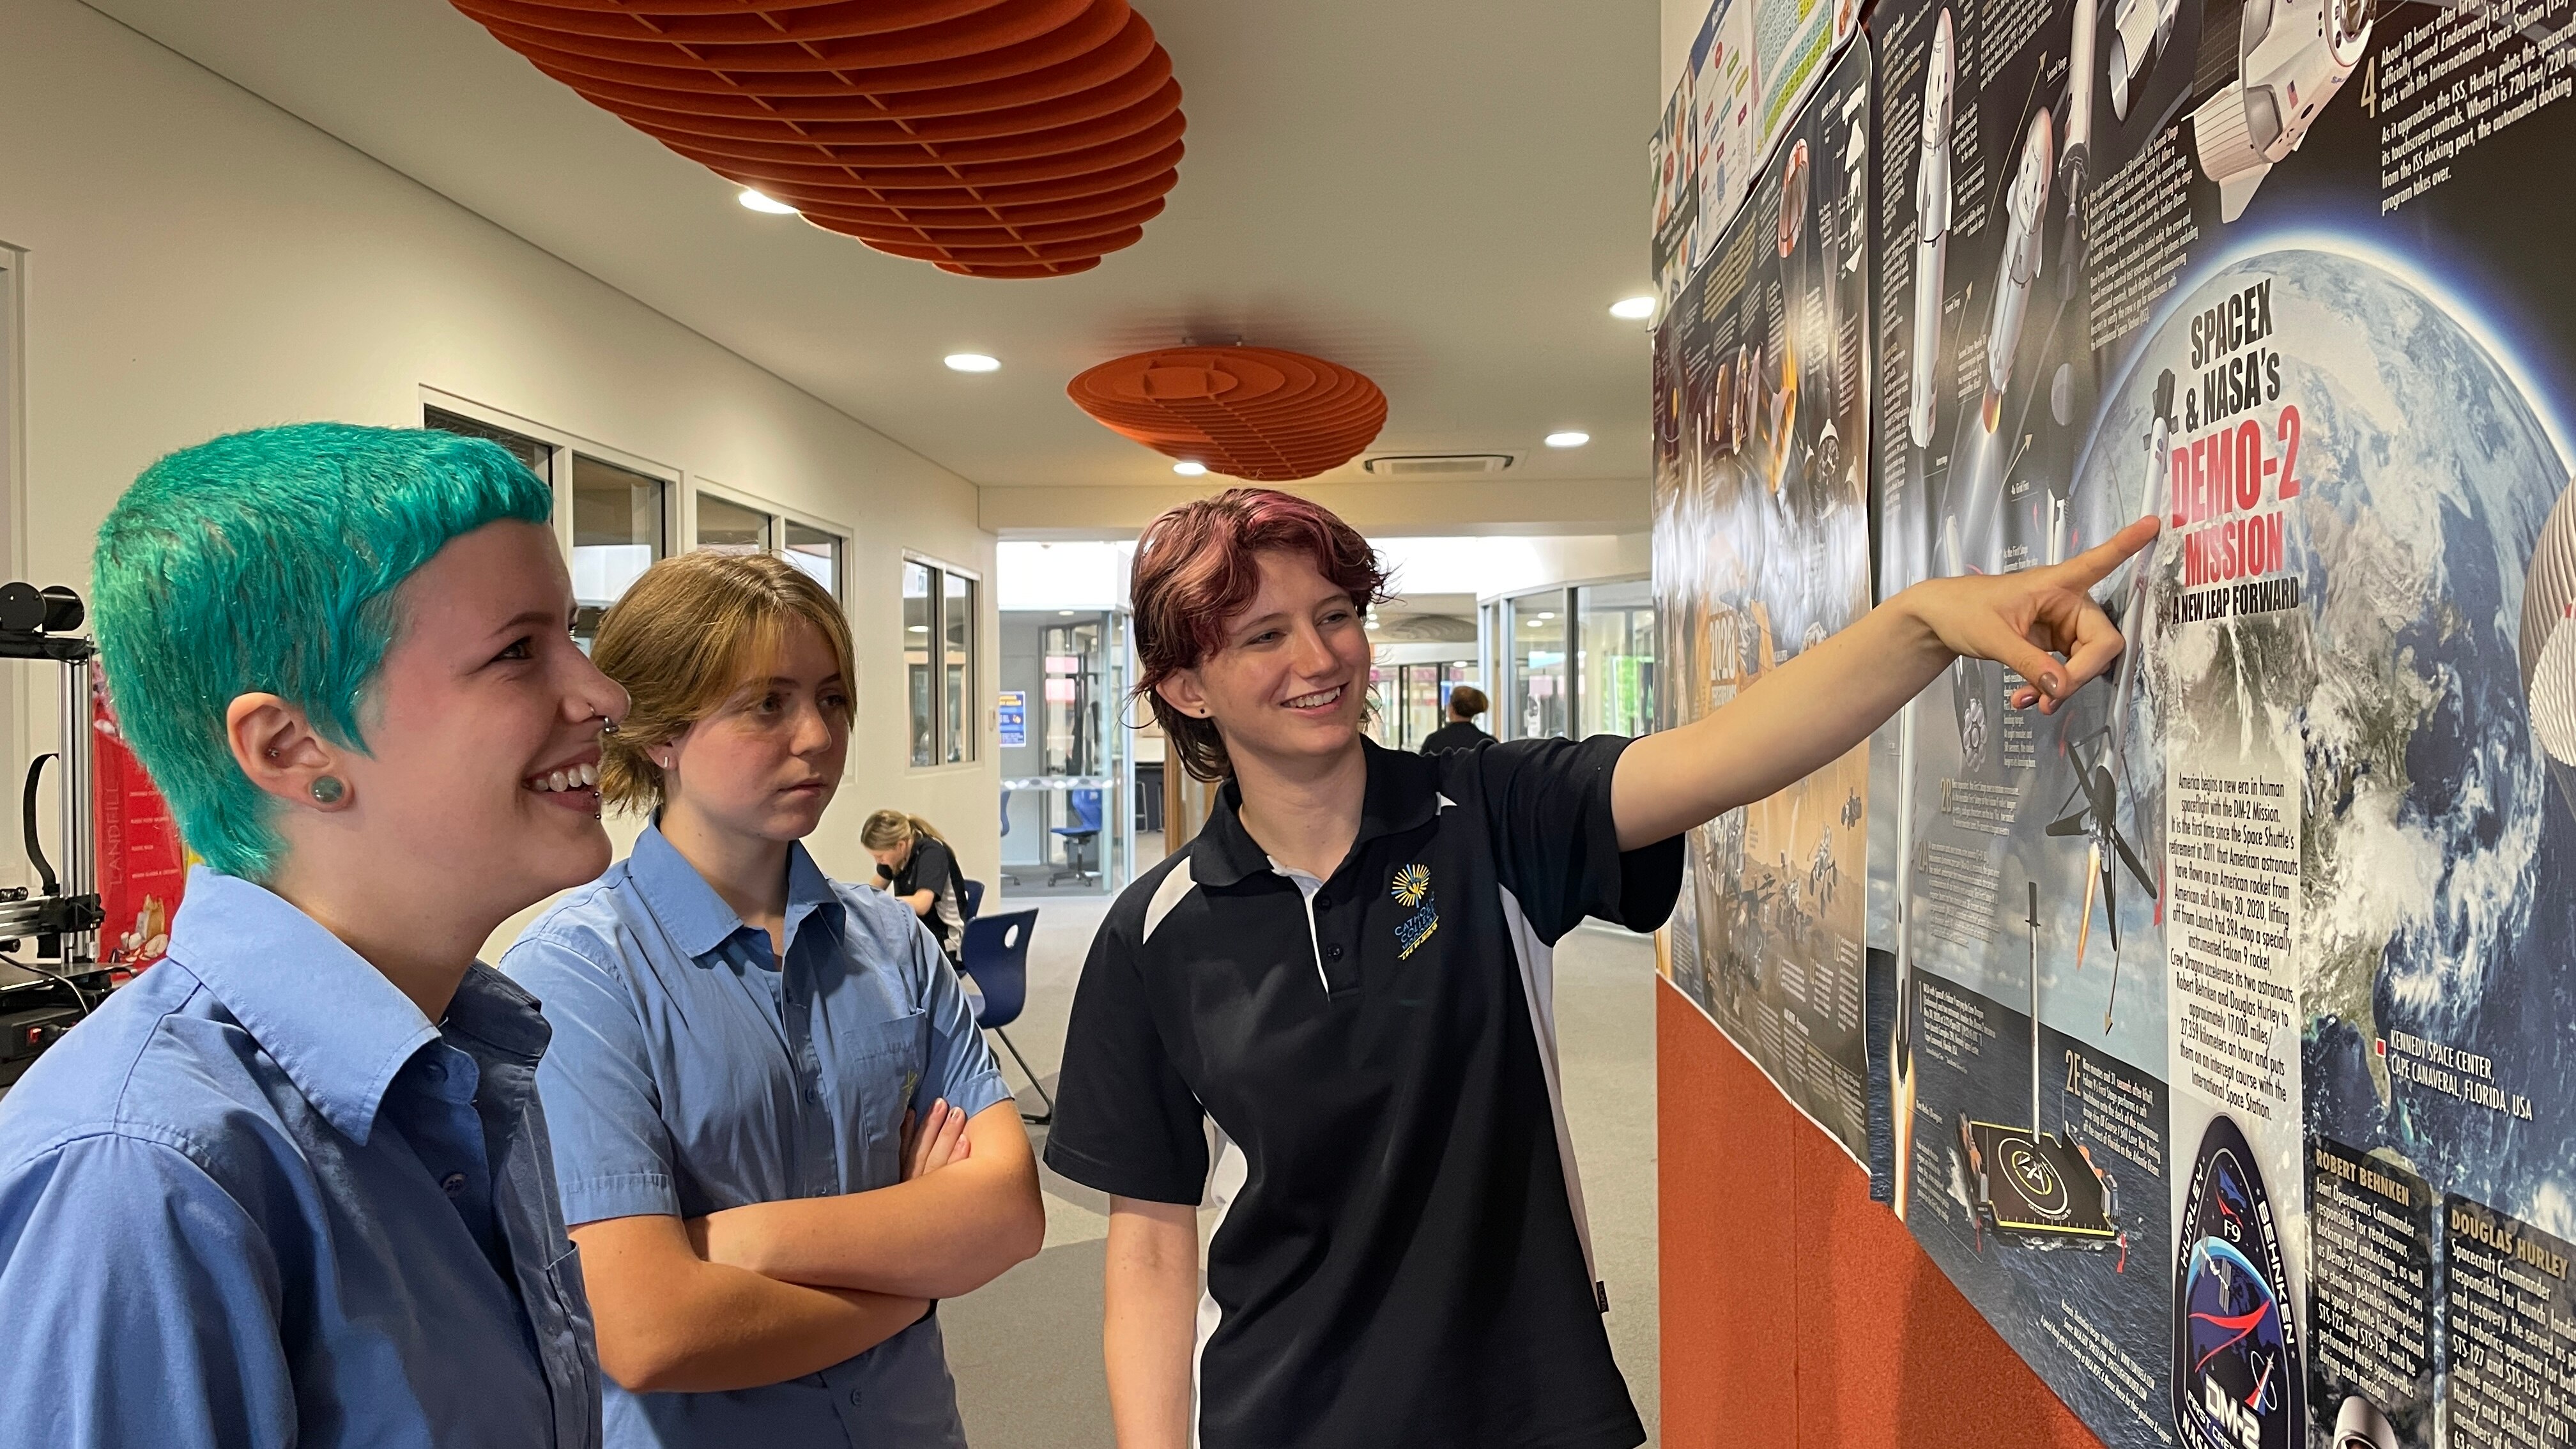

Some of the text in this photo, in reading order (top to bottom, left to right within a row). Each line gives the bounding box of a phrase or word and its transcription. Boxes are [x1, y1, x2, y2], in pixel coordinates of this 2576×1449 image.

[2381, 41, 2402, 67] About
[2404, 31, 2412, 52] 18
[2414, 21, 2434, 45] hours
[2436, 6, 2457, 29] after
[2381, 56, 2411, 89] officially
[2413, 35, 2438, 69] named
[2441, 5, 2489, 51] Endeavour)
[2491, 3, 2499, 21] is
[2501, 0, 2510, 20] in
[2382, 87, 2398, 112] dock
[2400, 76, 2414, 100] with
[2416, 70, 2427, 91] the
[2430, 33, 2485, 82] International
[2487, 24, 2511, 52] Space
[2514, 4, 2544, 33] Station
[2361, 56, 2377, 118] 4
[2382, 42, 2535, 144] As it approaches the ISS, Hurley pilots the
[2382, 150, 2391, 166] its
[2391, 128, 2432, 162] touchscreen
[2432, 105, 2465, 138] controls.
[2466, 96, 2492, 120] When
[2492, 86, 2498, 108] it
[2500, 86, 2508, 102] is
[2509, 76, 2526, 98] 720
[2382, 77, 2572, 188] from the ISS docking port, the automated docking
[2082, 196, 2088, 240] 3
[2382, 167, 2451, 216] program takes over.
[2191, 278, 2273, 371] SPACEX
[2186, 388, 2199, 433] &
[2172, 404, 2301, 529] DEMO-2
[2185, 510, 2283, 587] MISSION
[2173, 577, 2299, 625] A NEW LEAP FORWARD
[1710, 615, 1735, 681] 2020
[2234, 799, 2280, 822] DM-2 Mission.
[2238, 781, 2248, 794] era
[2251, 777, 2257, 795] in
[2260, 775, 2284, 797] human
[105, 782, 123, 885] LANDFILL
[2229, 847, 2297, 876] American astronauts
[2231, 822, 2294, 849] the Space Shuttle's
[2227, 917, 2292, 956] 39A atop a specially
[2235, 896, 2288, 931] 30, 2020, lifting
[2223, 940, 2271, 976] Falcon 9 rocket,
[2066, 1049, 2081, 1097] 2E
[2391, 1029, 2495, 1085] KENNEDY SPACE CENTER,
[2391, 1054, 2533, 1121] CAPE CANAVERAL, FLORIDA, USA
[2316, 1149, 2409, 1207] ROBERT BEHNKEN
[2316, 1176, 2414, 1238] Joint Operations Commander
[2181, 1163, 2203, 1268] HURLEY
[2223, 1219, 2241, 1243] F9
[2317, 1200, 2409, 1261] responsible for rendezvous,
[2451, 1209, 2568, 1280] DOUGLAS HURLEY
[2258, 1200, 2295, 1344] BEHNKEN
[2317, 1245, 2422, 1312] as Demo-2 mission activities on
[2451, 1238, 2550, 1301] Spacecraft Commander
[2452, 1268, 2549, 1331] responsible for launch,
[2318, 1284, 2424, 1358] two space shuttle flights aboard
[2319, 1303, 2415, 1376] STS-123 and STS-130, and he
[2452, 1291, 2566, 1362] and recovery. He served as
[2453, 1334, 2559, 1411] STS-127 and STS-135, the
[2453, 1358, 2572, 1446] shuttle mission in July 2011.
[2188, 1390, 2211, 1429] FIRST
[2205, 1373, 2260, 1449] DM-2
